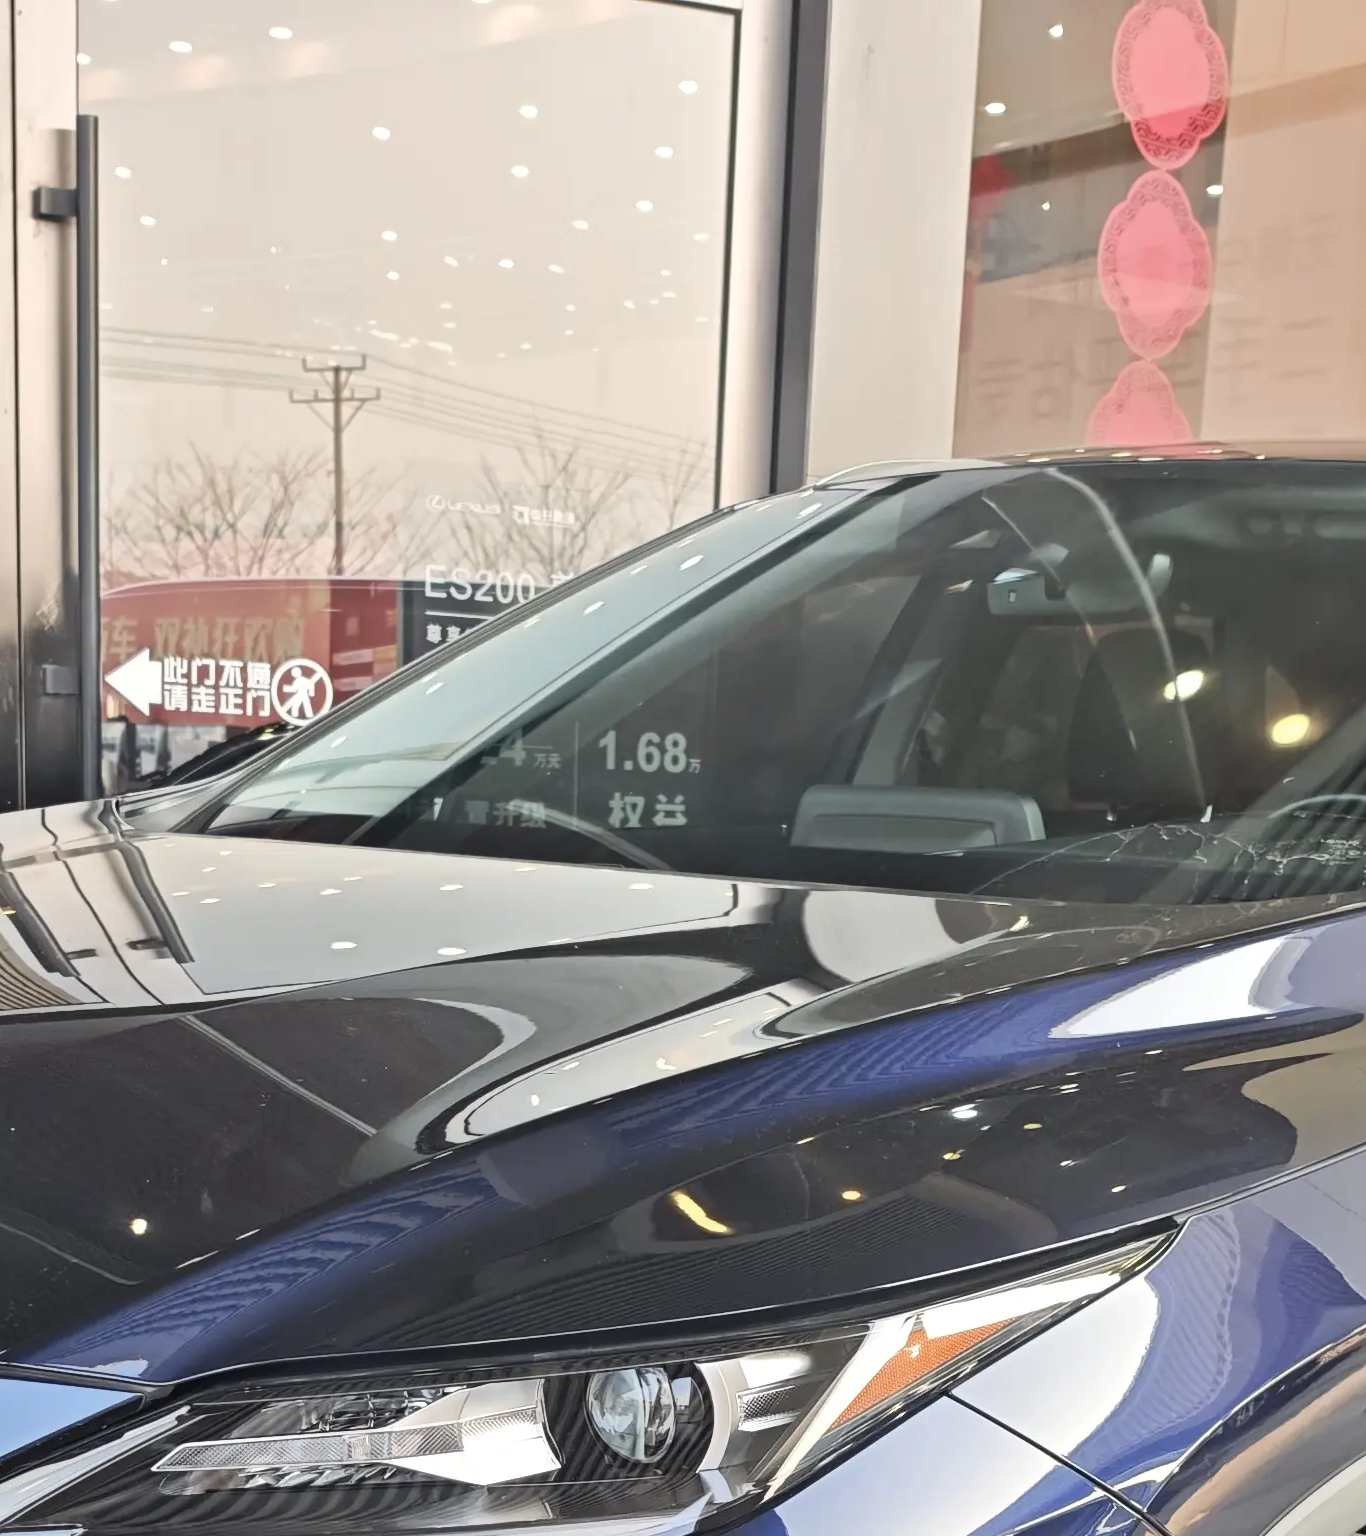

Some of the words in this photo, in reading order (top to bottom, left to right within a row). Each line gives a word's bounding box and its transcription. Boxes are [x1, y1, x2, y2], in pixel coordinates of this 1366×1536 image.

[424, 564, 536, 604] ES200
[162, 655, 272, 690] 此门不通
[163, 684, 272, 717] 请走正门
[608, 792, 688, 829] 权益
